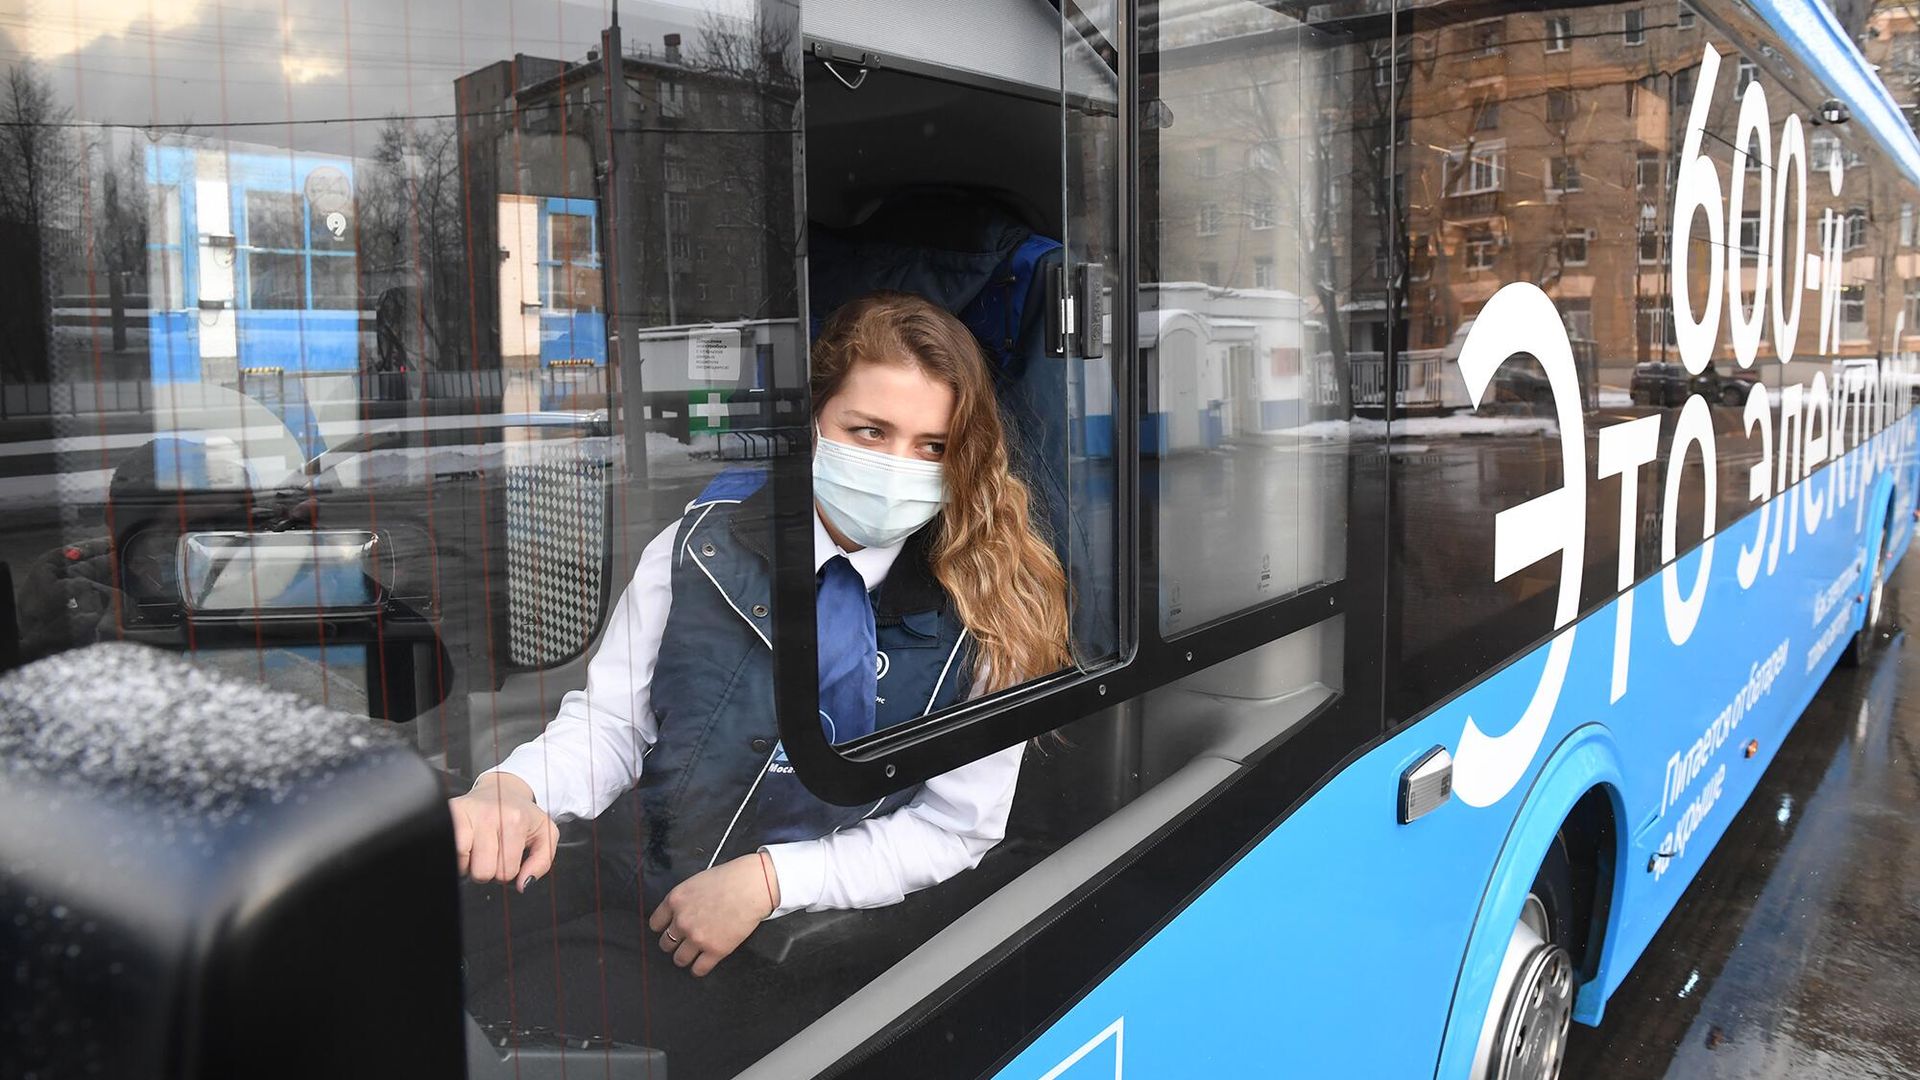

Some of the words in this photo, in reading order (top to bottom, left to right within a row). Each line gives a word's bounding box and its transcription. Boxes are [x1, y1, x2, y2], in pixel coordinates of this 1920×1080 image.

[1672, 41, 1845, 376] 600-й
[1452, 281, 1717, 808] Это
[1659, 703, 1732, 818] Питается
[1731, 684, 1748, 730] от
[1745, 636, 1790, 712] батареи
[1672, 763, 1726, 859] крыше
